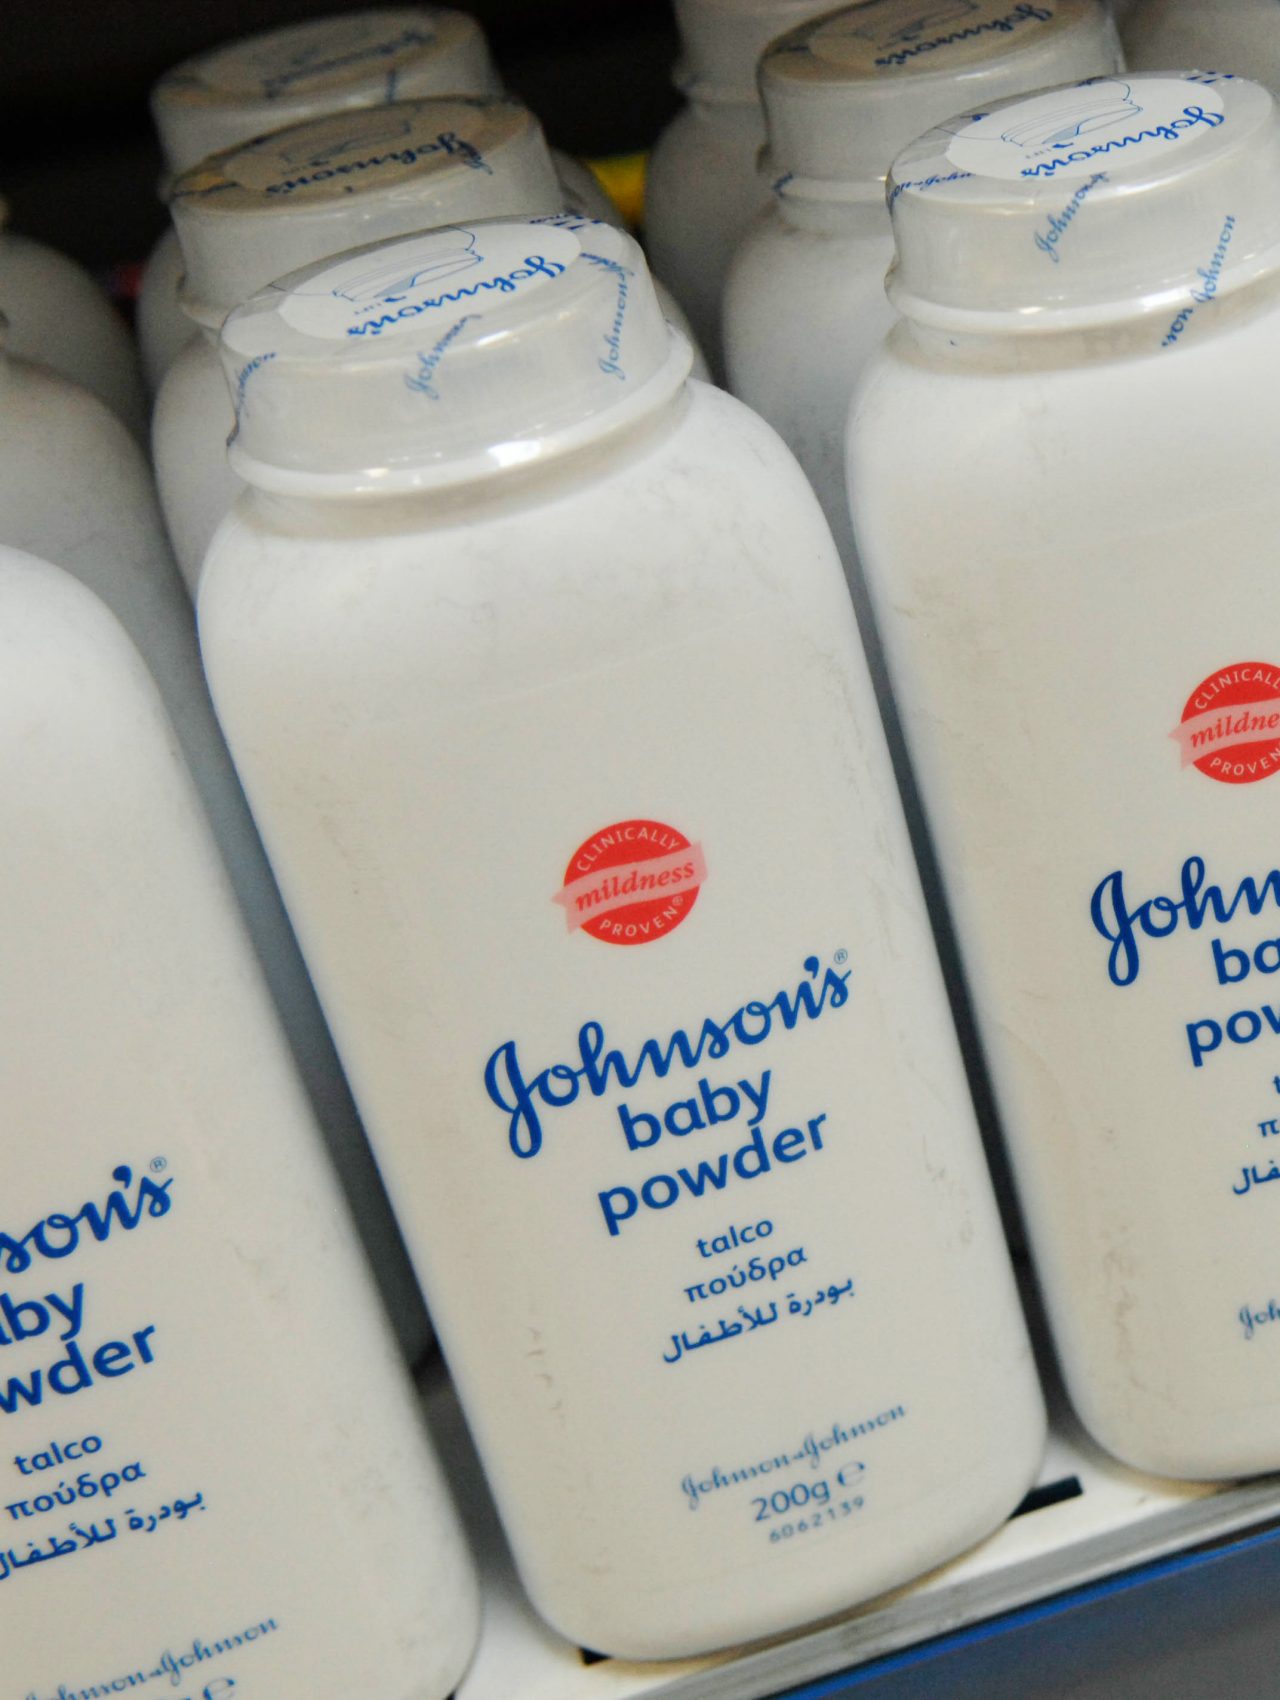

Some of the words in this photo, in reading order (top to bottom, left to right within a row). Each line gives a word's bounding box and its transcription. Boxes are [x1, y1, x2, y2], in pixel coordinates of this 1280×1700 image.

[1021, 106, 1224, 177] Johnson's
[347, 255, 566, 336] Johnson's
[576, 826, 681, 872] CLINICALLY
[575, 861, 695, 912] mildness
[617, 1069, 771, 1152] baby
[597, 1113, 827, 1237] powder
[696, 1219, 773, 1258] talco
[684, 1246, 808, 1303] πούδρα
[788, 1277, 855, 1316] بودرة
[0, 1282, 84, 1346] by
[0, 1325, 156, 1414] wder
[14, 1435, 102, 1476] talco
[4, 1459, 146, 1521] πούδρα
[128, 1492, 206, 1532] بودرة
[751, 1479, 831, 1522] 200g
